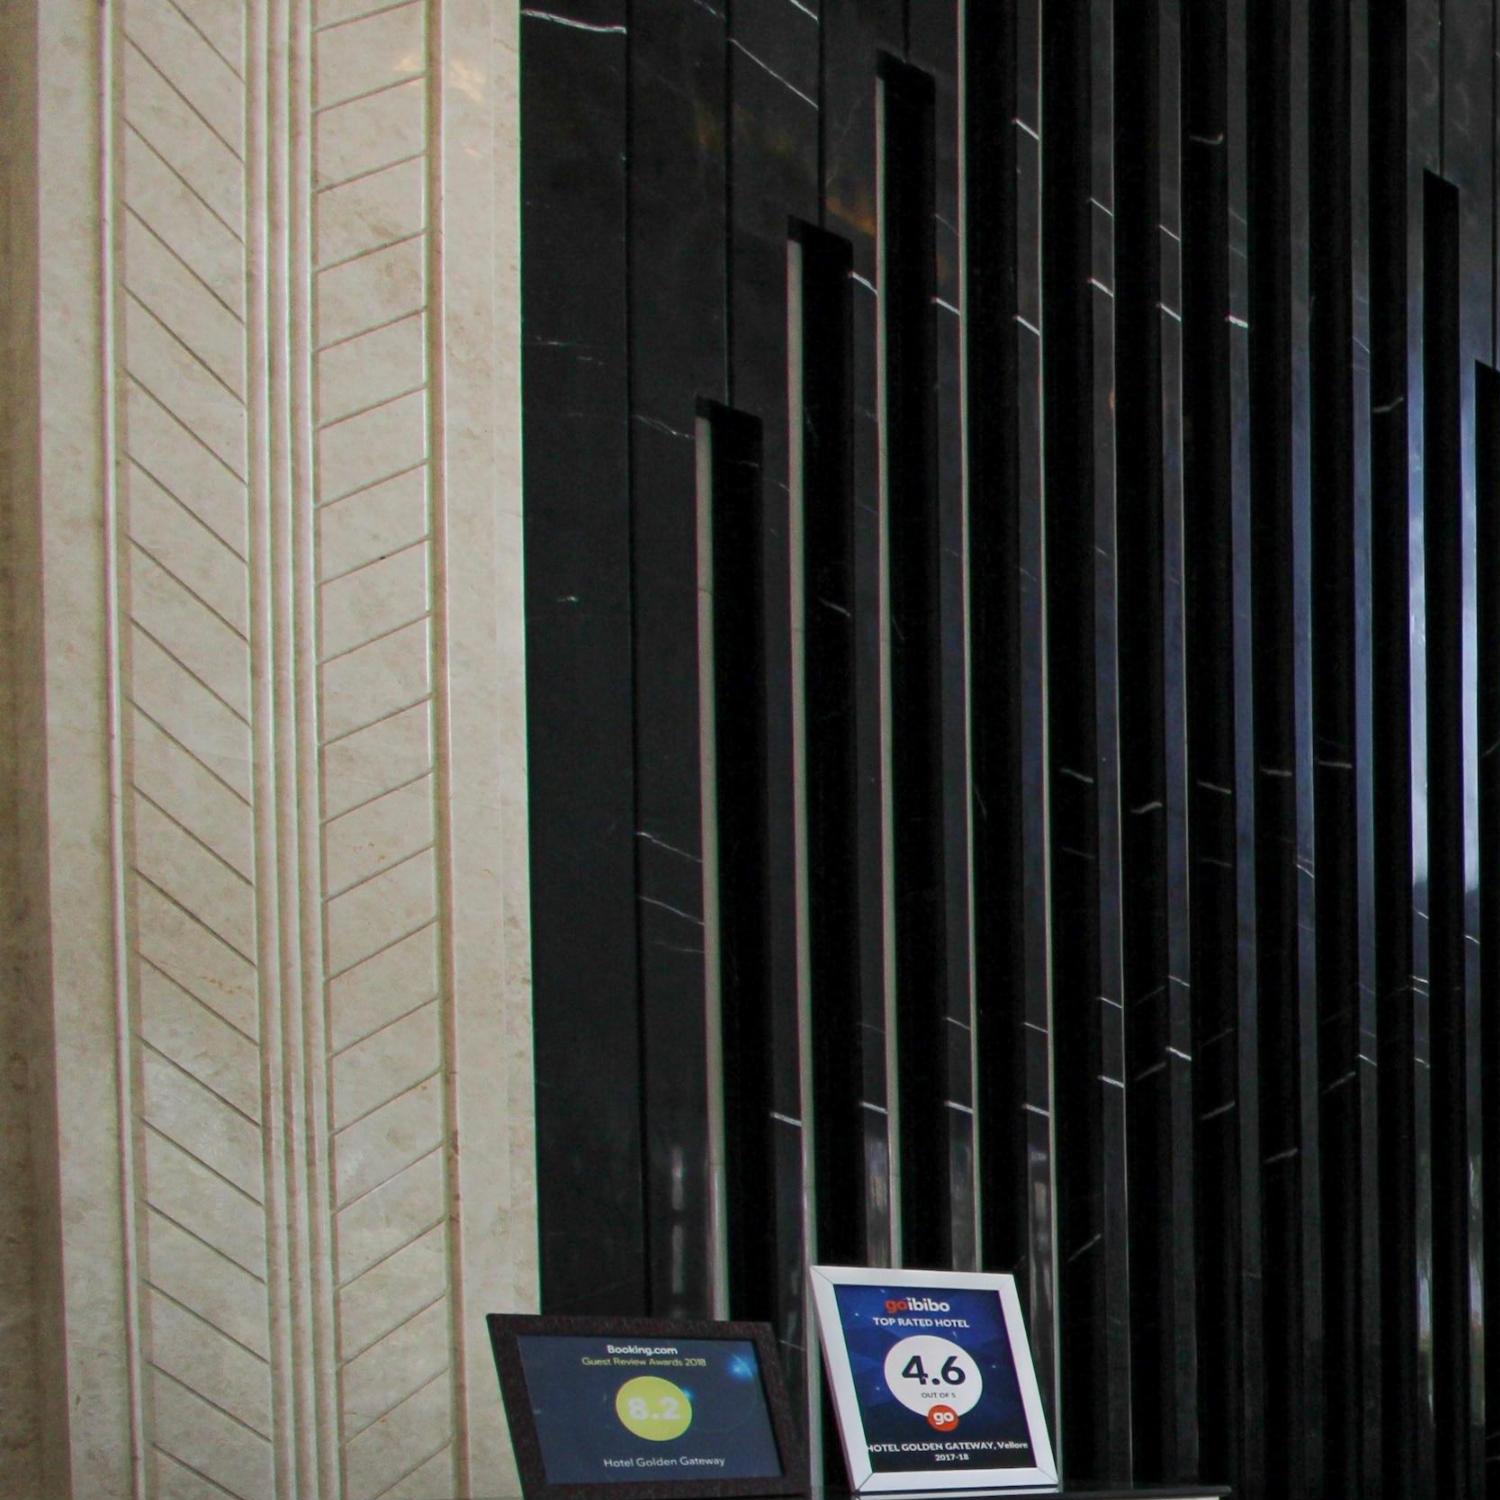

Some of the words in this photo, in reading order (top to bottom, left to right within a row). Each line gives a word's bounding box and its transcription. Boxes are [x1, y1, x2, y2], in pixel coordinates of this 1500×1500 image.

[885, 1297, 951, 1314] goibibo
[872, 1317, 897, 1327] TOP
[898, 1318, 934, 1327] RATED
[935, 1319, 970, 1329] HOTEL
[607, 1344, 679, 1357] Booking.com
[581, 1356, 612, 1367] Guest
[649, 1358, 683, 1368] Awards
[901, 1355, 966, 1386] 4.6
[921, 1392, 937, 1400] OUT
[939, 1392, 949, 1400] OF
[628, 1396, 681, 1421] 8.2
[933, 1411, 955, 1425] go
[901, 1442, 944, 1452] GOLDEN
[603, 1457, 634, 1468] Hotel
[636, 1456, 678, 1467] Golden
[679, 1455, 726, 1467] Gateway
[934, 1453, 970, 1462] 2017-18
